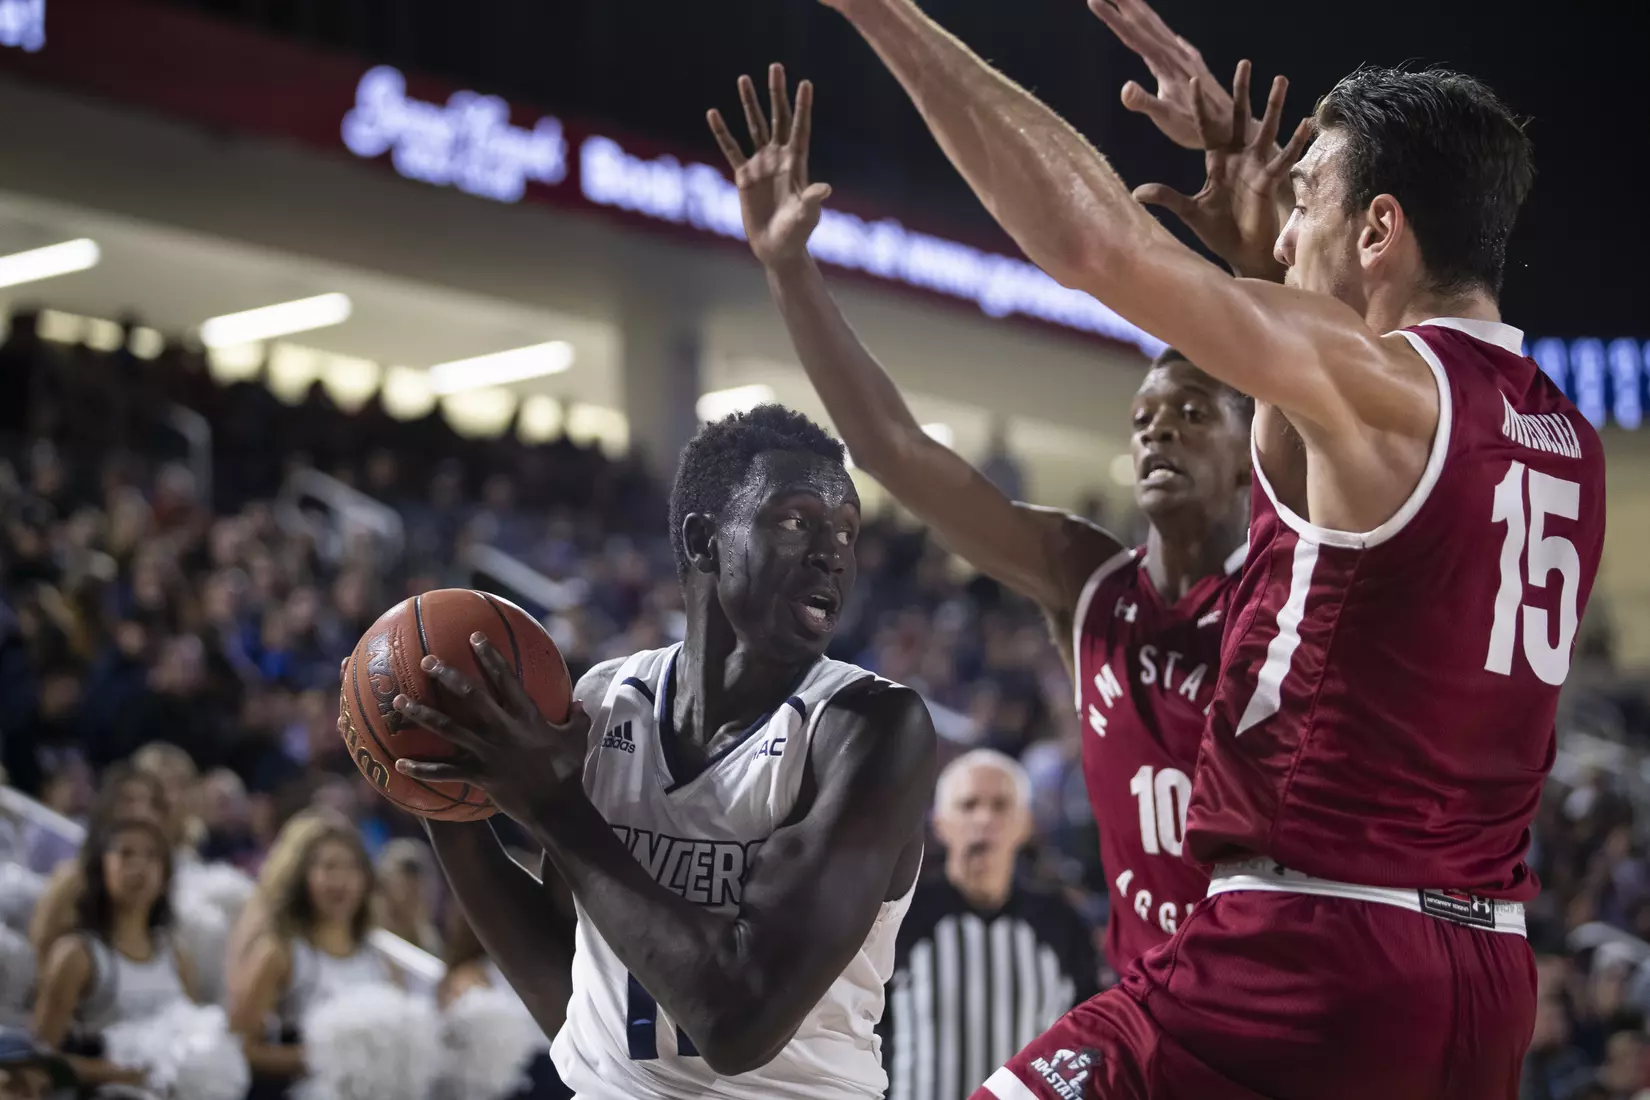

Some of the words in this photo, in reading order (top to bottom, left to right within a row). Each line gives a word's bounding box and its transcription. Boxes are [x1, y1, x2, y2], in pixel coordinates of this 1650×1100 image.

[1484, 459, 1580, 685] 15
[1089, 663, 1123, 737] NM
[1140, 645, 1212, 716] STA
[752, 737, 787, 760] AC
[1130, 765, 1192, 857] 10
[610, 824, 768, 906] NCER
[1116, 869, 1194, 935] AGG
[1030, 1056, 1054, 1077] NM
[1046, 1072, 1083, 1100] STAT
